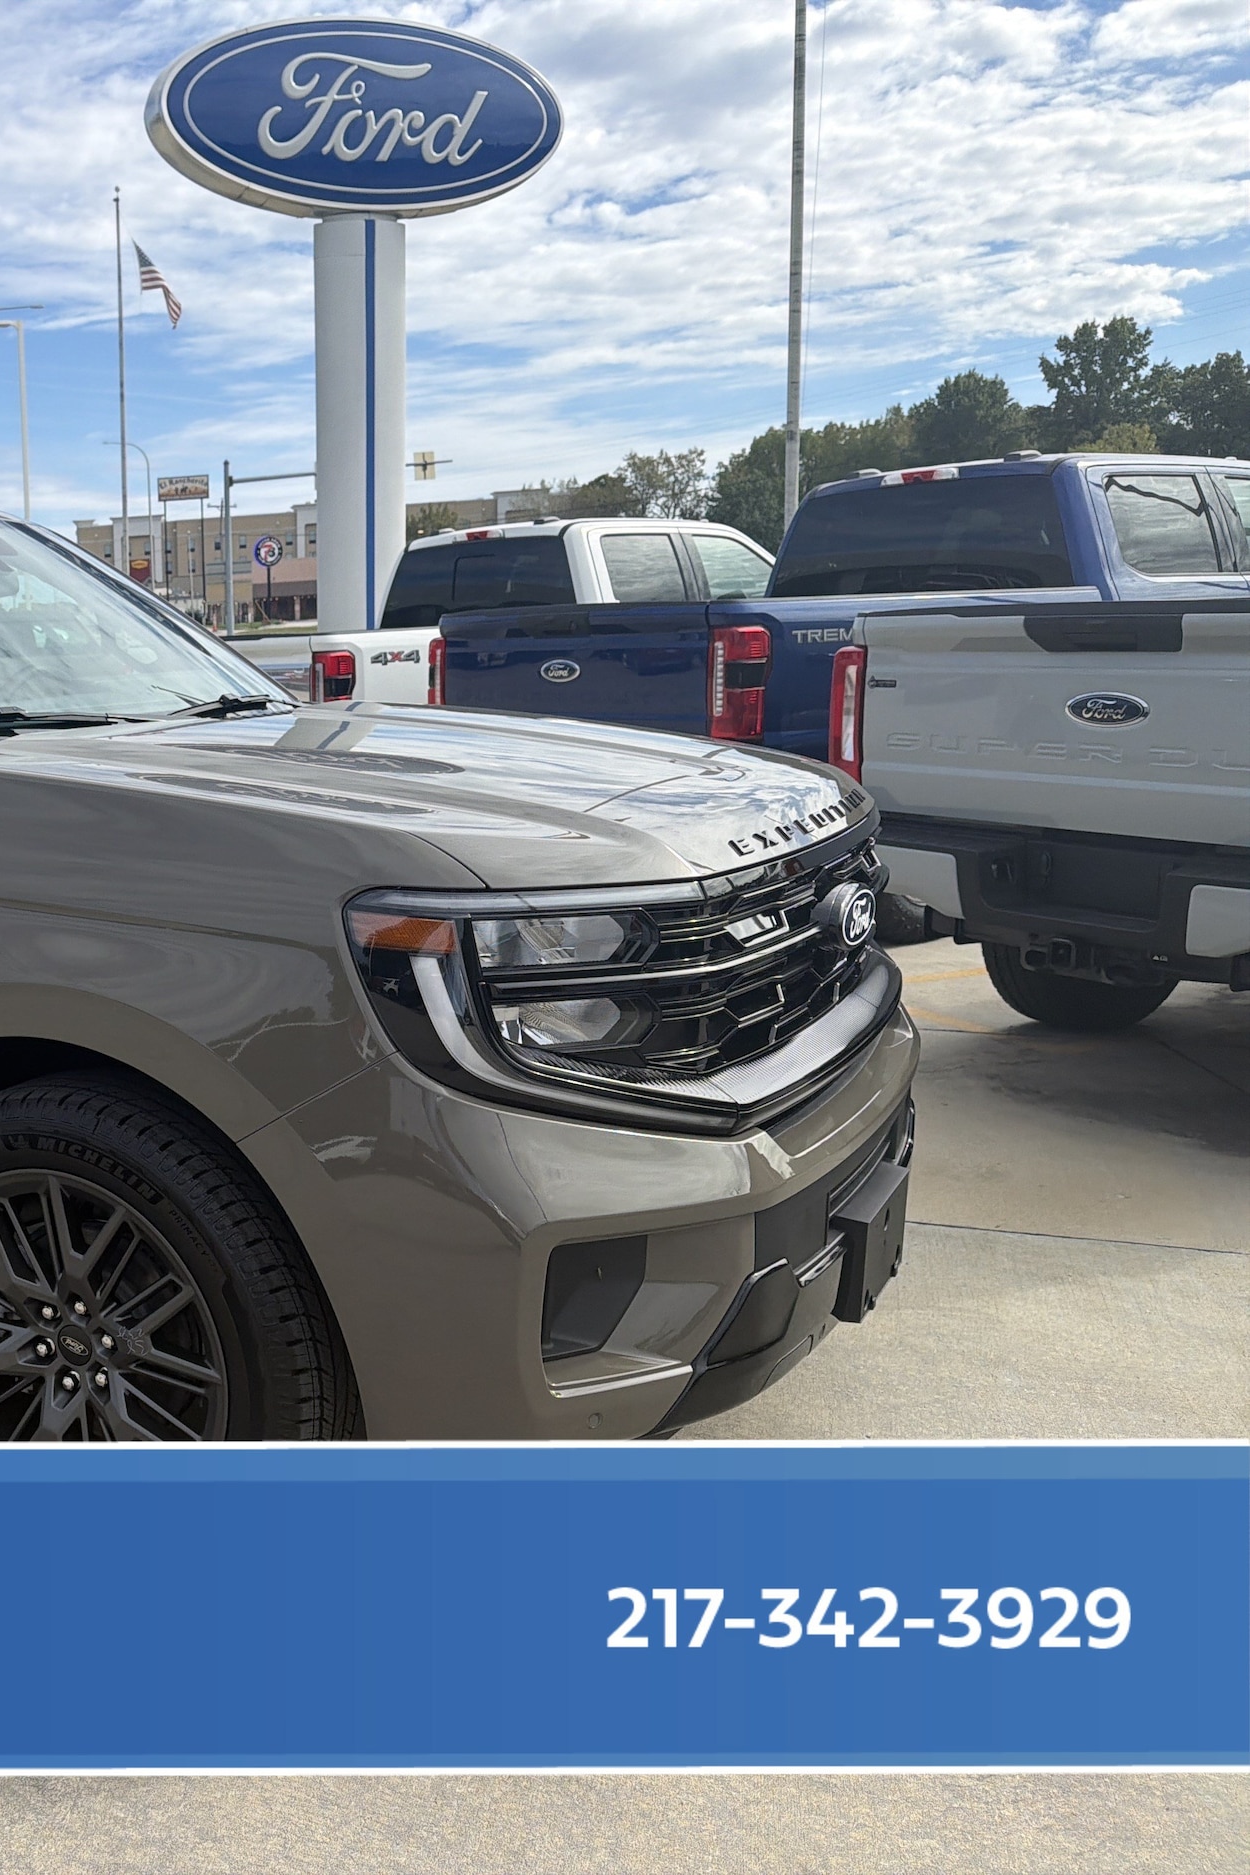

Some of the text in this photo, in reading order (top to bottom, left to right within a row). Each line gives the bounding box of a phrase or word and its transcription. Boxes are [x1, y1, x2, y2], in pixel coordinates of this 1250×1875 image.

[257, 51, 489, 167] Ford
[548, 664, 570, 677] Ford
[1081, 698, 1128, 720] Ford
[886, 732, 1123, 764] SUPER
[850, 897, 871, 939] Ford
[36, 1136, 159, 1203] MICHELIN
[168, 1209, 210, 1257] PRIMACY
